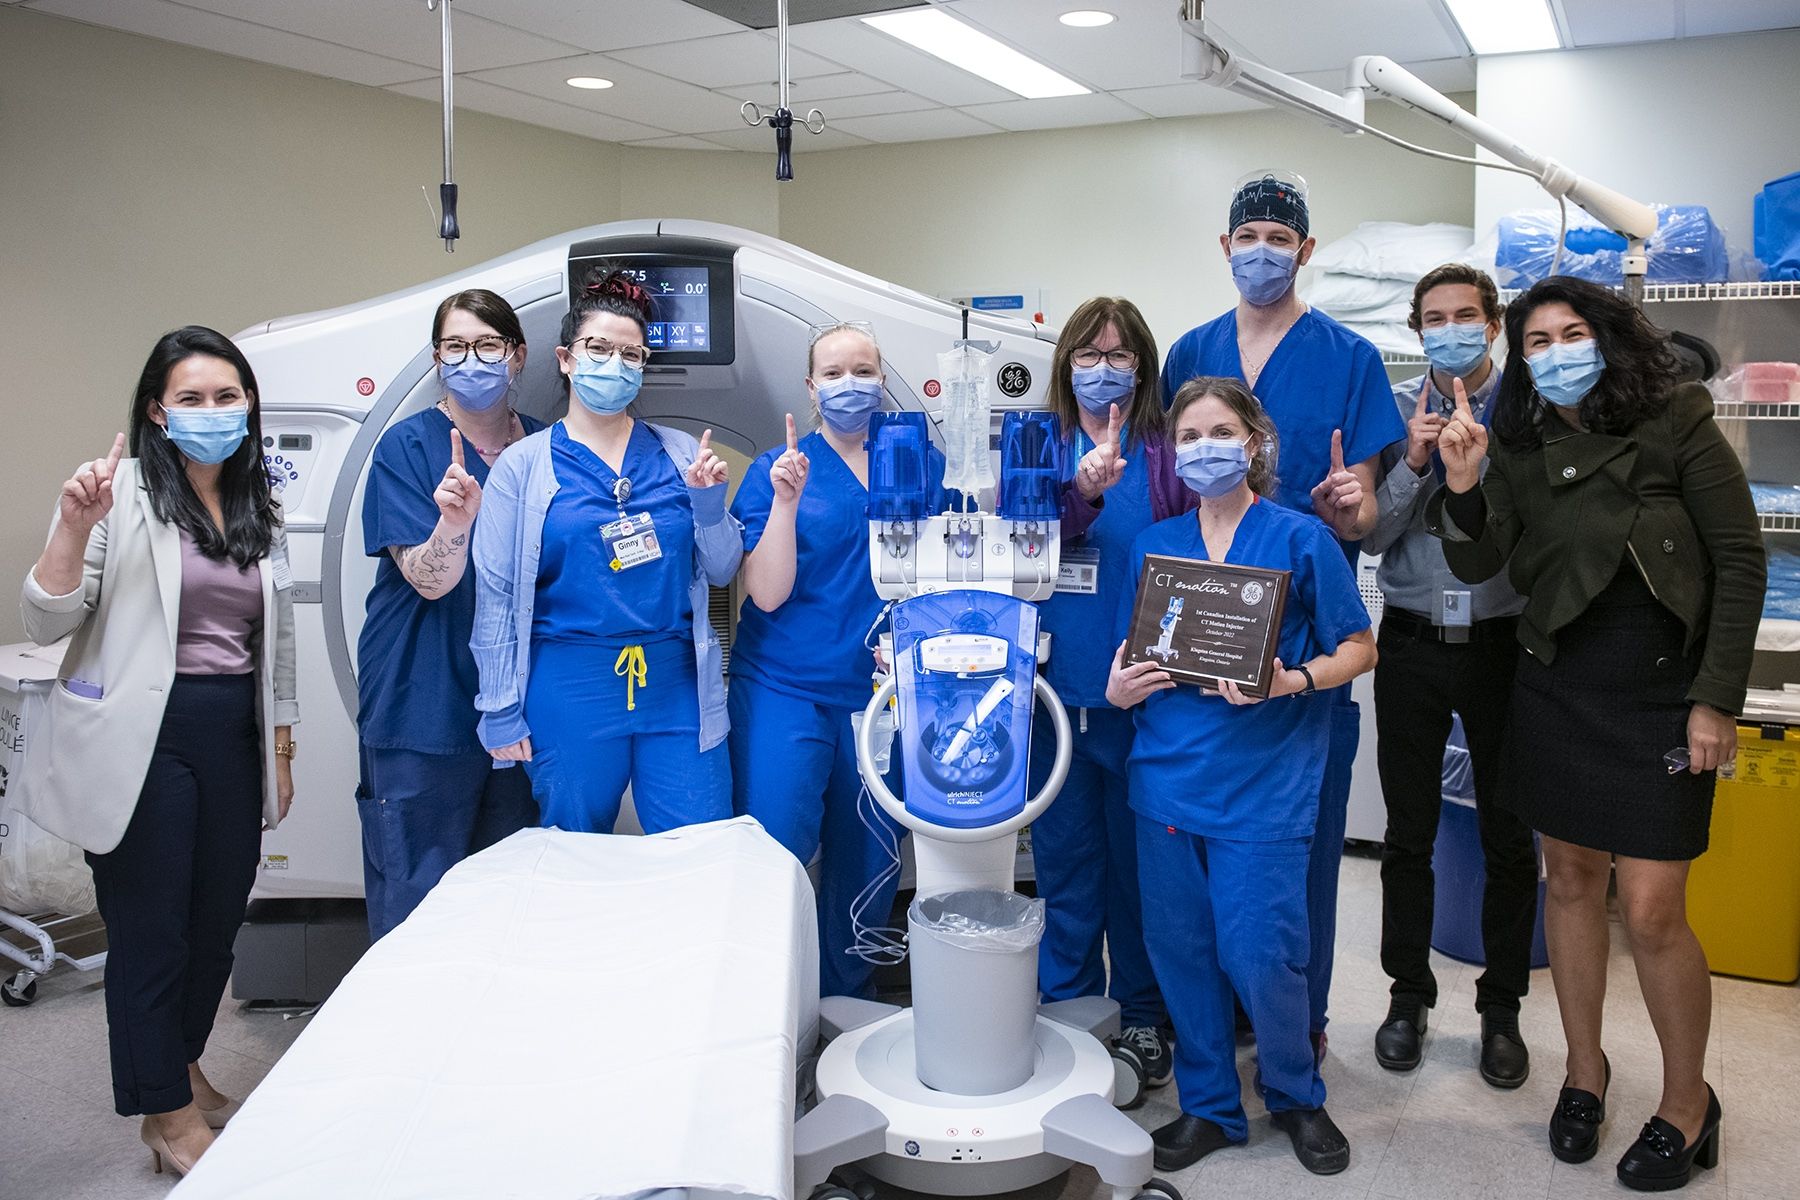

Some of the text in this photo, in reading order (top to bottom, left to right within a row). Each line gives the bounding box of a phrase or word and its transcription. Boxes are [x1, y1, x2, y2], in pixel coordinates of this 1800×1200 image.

[671, 326, 686, 336] XY
[618, 539, 639, 550] Ginny
[1060, 567, 1074, 575] Kelly
[1155, 573, 1174, 587] CT
[1203, 610, 1225, 619] Canadian
[1225, 613, 1251, 622] Installation
[1209, 620, 1225, 628] Motion
[1205, 628, 1223, 636] October
[1208, 649, 1225, 657] General
[1225, 652, 1243, 660] Hospital
